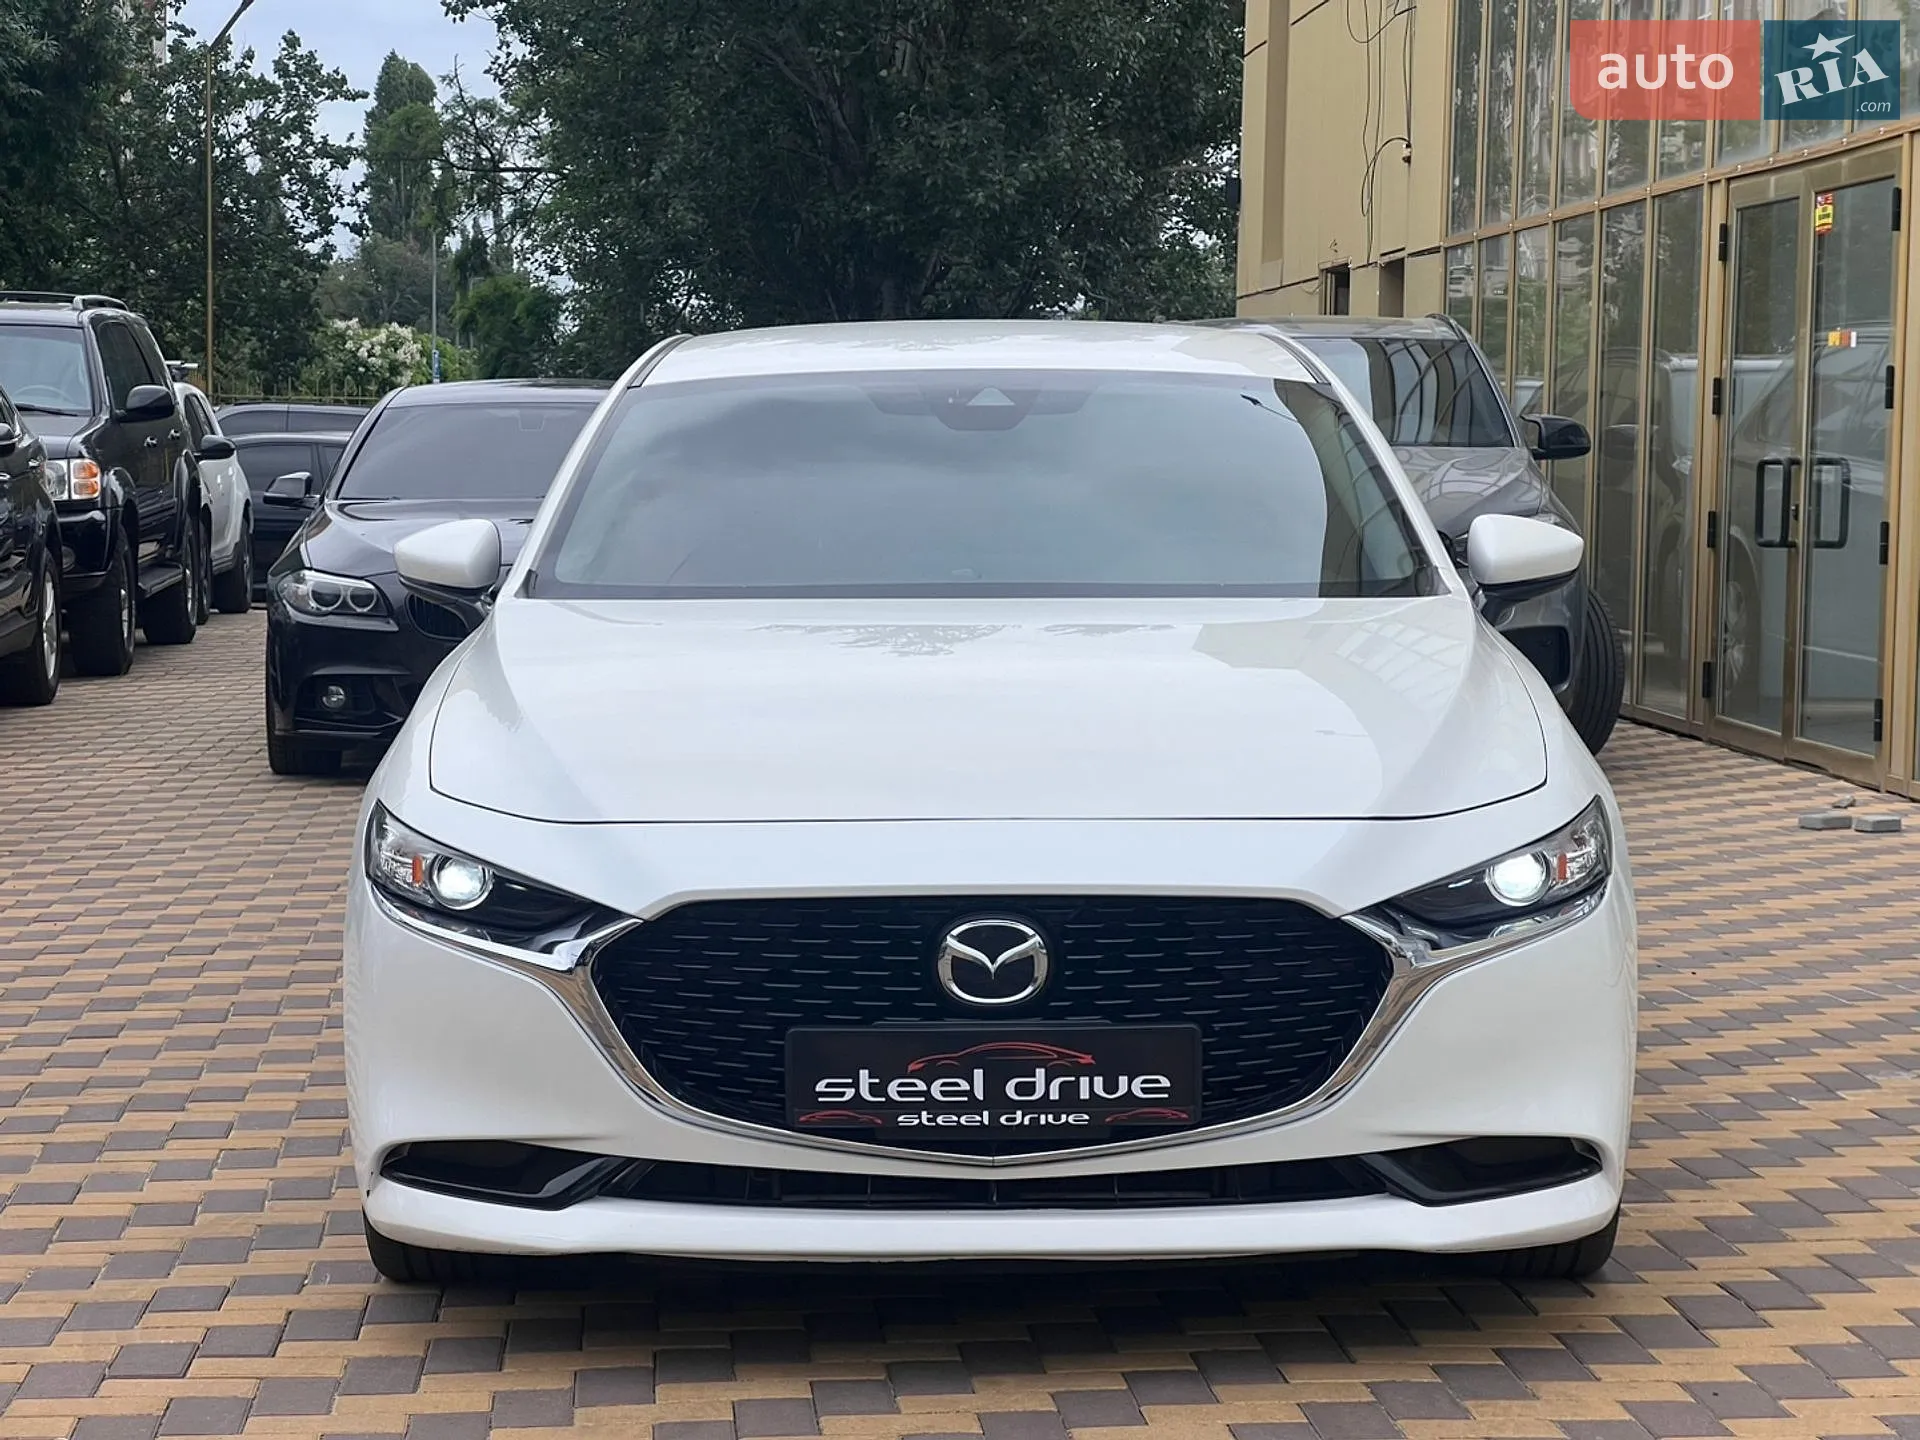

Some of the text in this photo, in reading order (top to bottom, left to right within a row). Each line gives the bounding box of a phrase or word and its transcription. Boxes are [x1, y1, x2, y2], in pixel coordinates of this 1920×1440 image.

[815, 1068, 1171, 1102] steel drive
[897, 1110, 1090, 1127] steel drive
